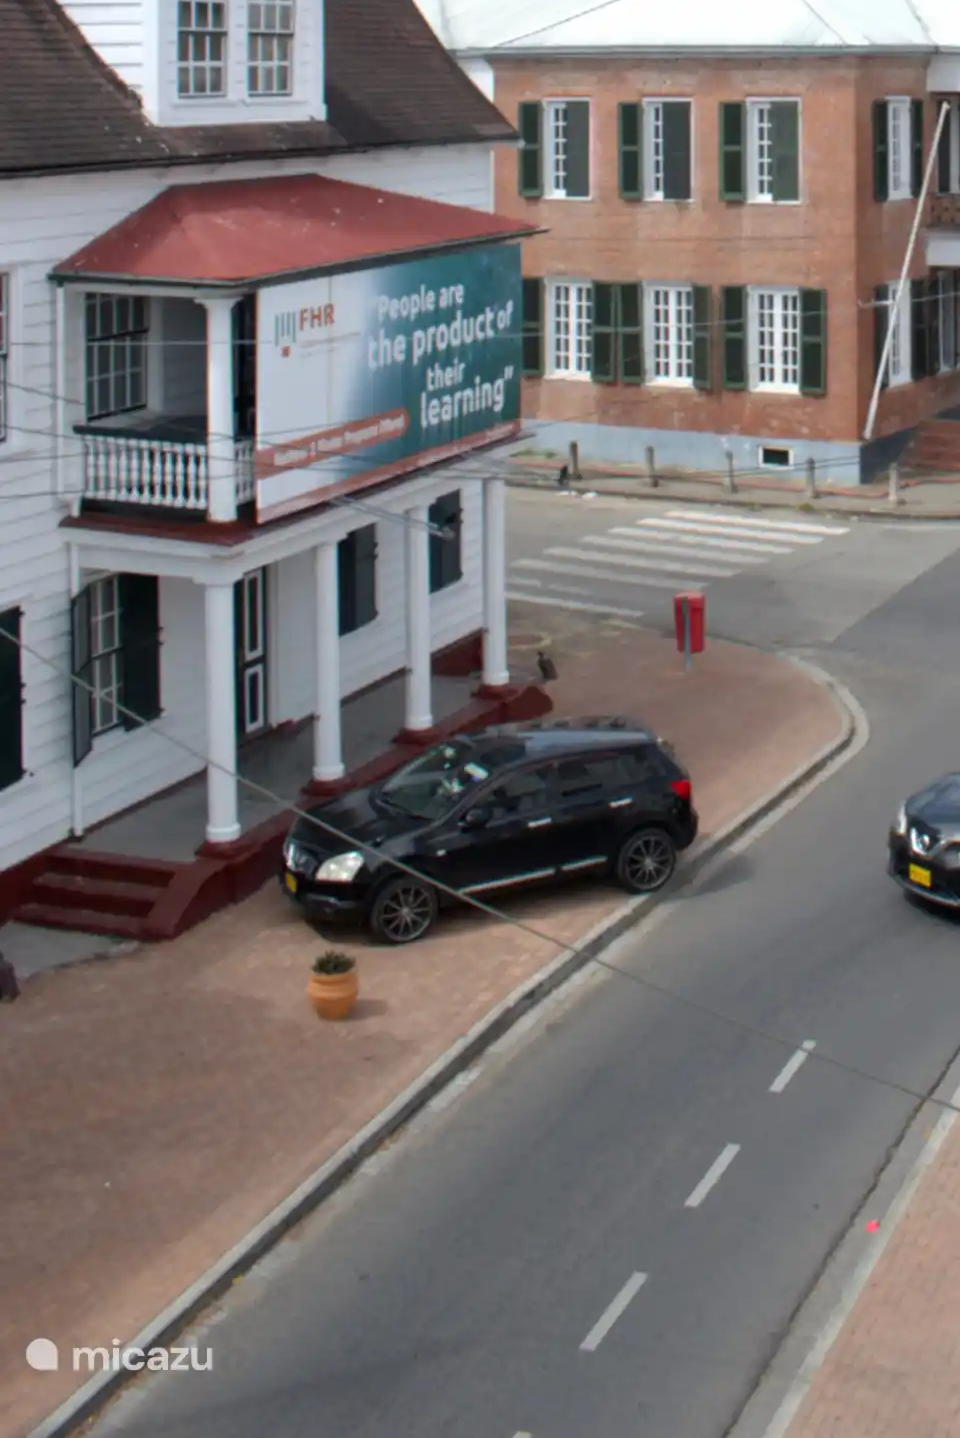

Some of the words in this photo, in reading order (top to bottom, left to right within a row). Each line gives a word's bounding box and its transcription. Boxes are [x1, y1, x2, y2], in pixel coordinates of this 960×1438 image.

[439, 283, 464, 309] are
[299, 303, 335, 331] FHR
[368, 328, 406, 370] the
[411, 307, 495, 366] product
[497, 299, 514, 330] of
[426, 357, 466, 392] their
